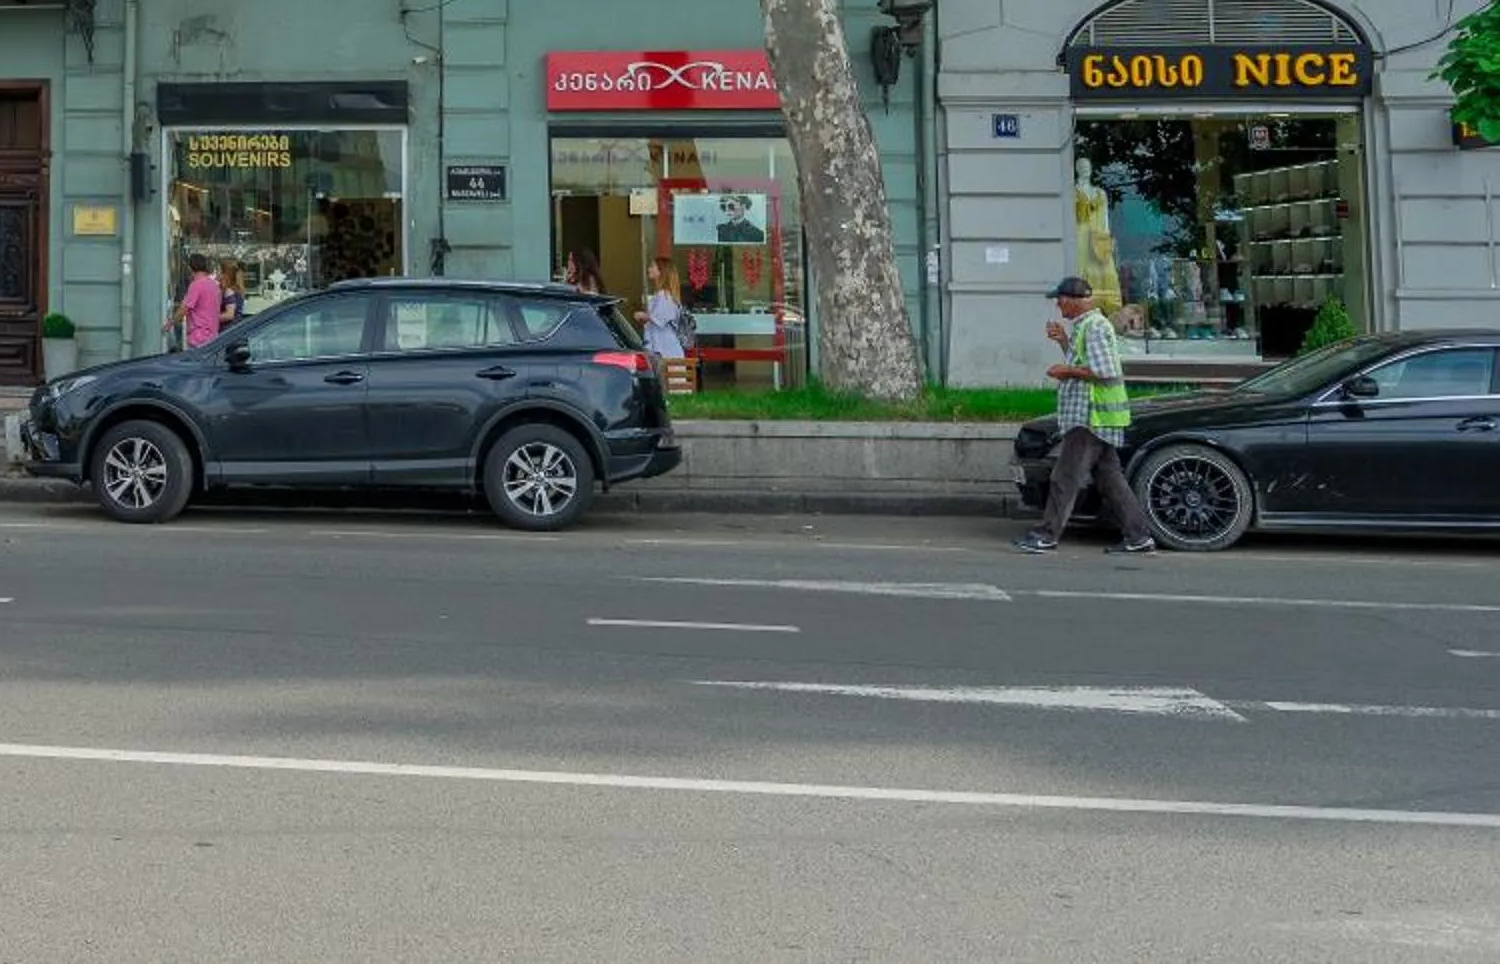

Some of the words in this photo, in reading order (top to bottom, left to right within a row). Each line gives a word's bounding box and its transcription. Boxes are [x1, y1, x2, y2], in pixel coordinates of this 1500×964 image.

[1084, 55, 1203, 86] ნაისი
[1234, 53, 1357, 85] NICE
[555, 72, 651, 91] კენარი
[702, 71, 777, 90] KENA
[188, 151, 291, 168] SOUVENIRS
